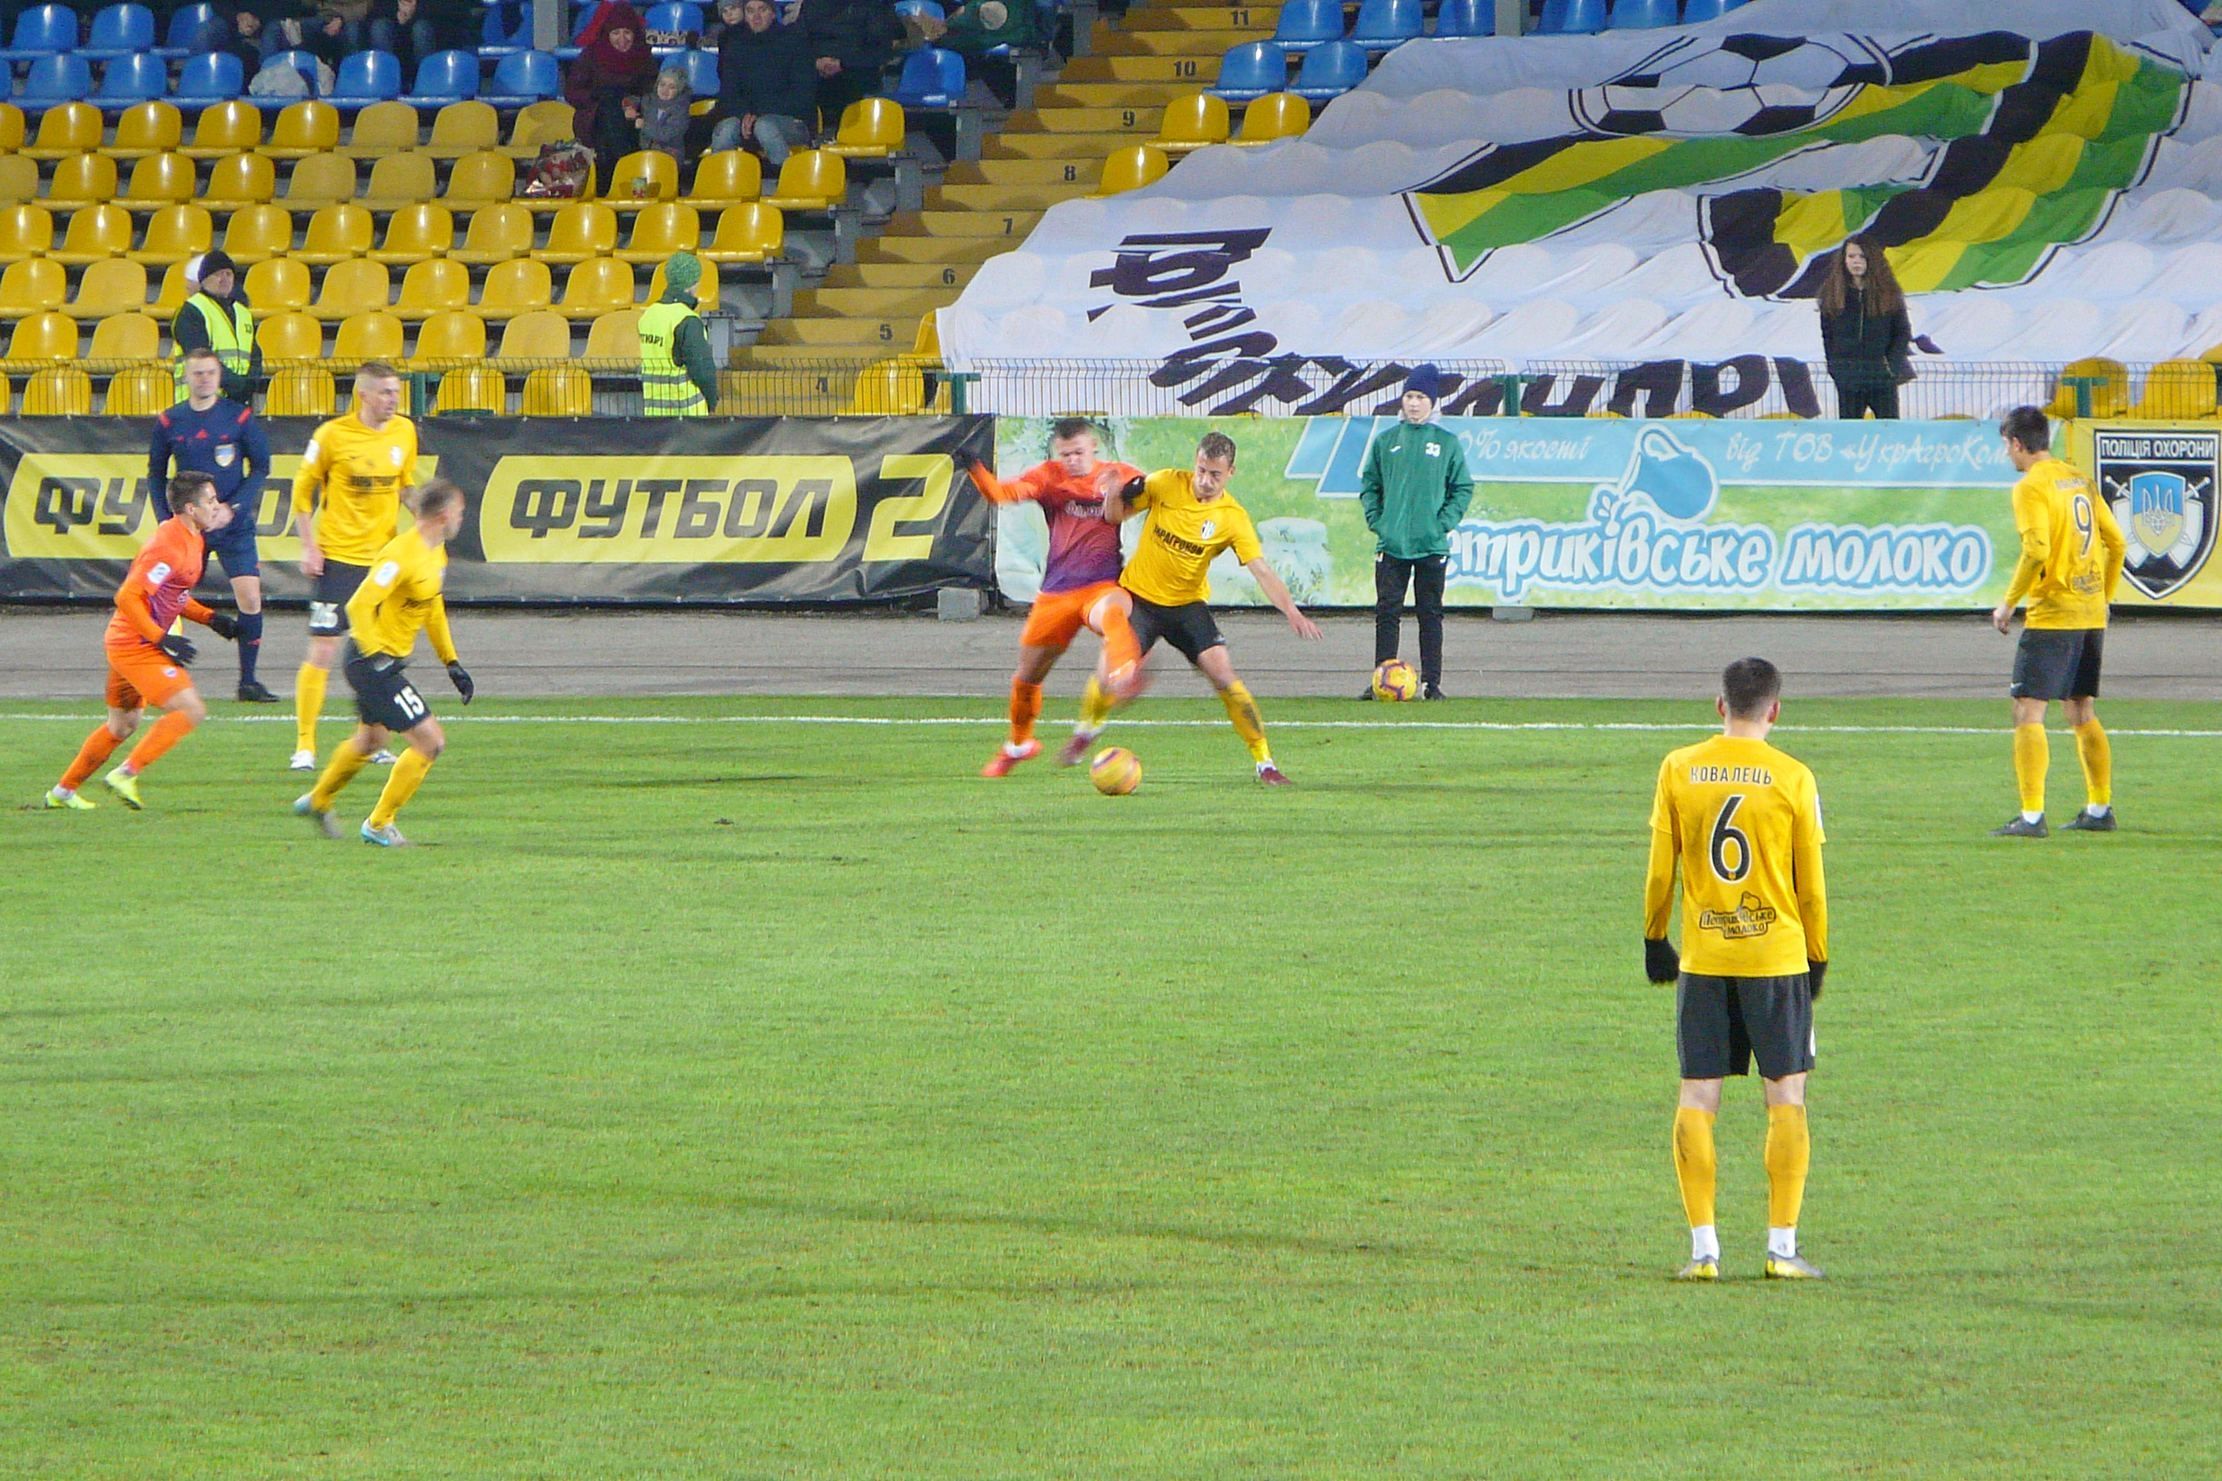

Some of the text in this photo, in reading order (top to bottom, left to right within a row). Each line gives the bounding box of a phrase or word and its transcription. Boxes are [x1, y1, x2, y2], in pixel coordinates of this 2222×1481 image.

[1231, 10, 1249, 26] 11
[1173, 60, 1197, 77] 10
[1122, 110, 1136, 127] 9
[1063, 164, 1077, 182] 8
[1003, 217, 1014, 235] 7
[942, 268, 956, 285] 6
[879, 323, 893, 341] 5
[1775, 430, 1833, 464] ТОВ
[2101, 439, 2214, 459] ПОЛІЦІЯ ОХОРОНИ
[509, 478, 834, 540] ФУТБОЛ
[861, 453, 955, 562] 2
[2074, 494, 2093, 558] 9
[1446, 516, 1982, 593] етриківське молоко
[394, 685, 425, 720] 15
[1690, 765, 1772, 786] КОВАЛЕЦЬ
[1709, 794, 1752, 884] 6
